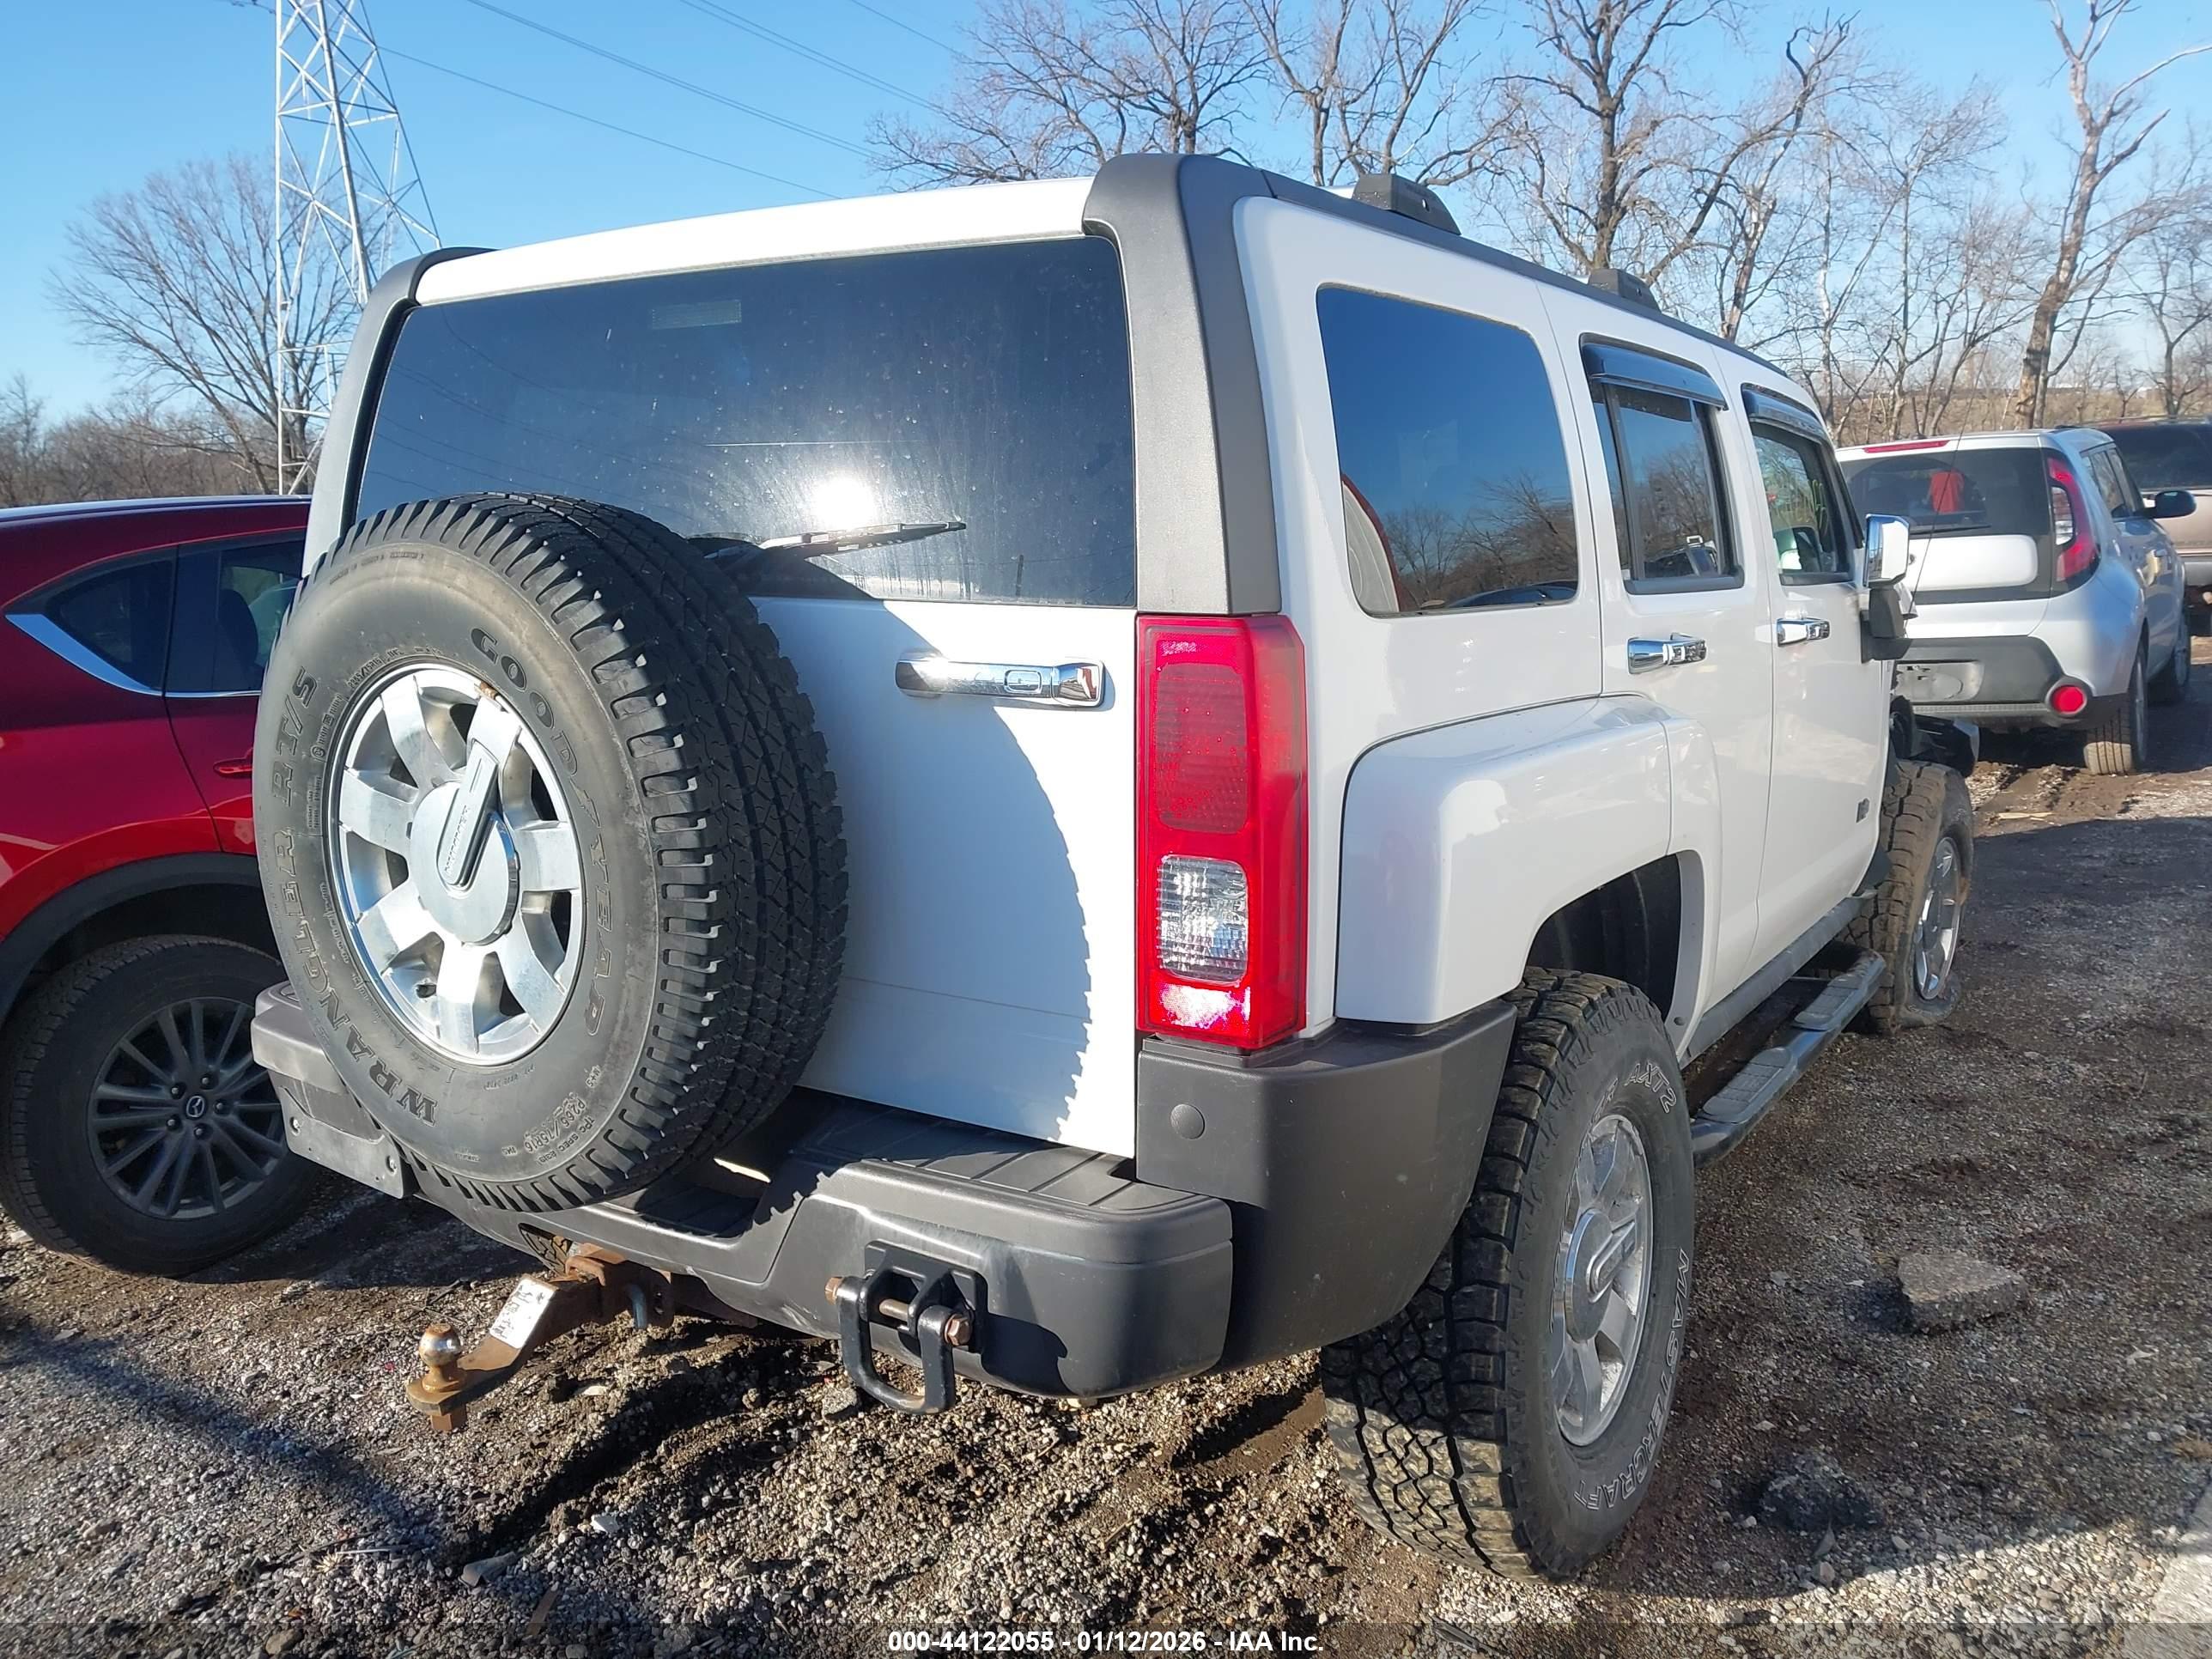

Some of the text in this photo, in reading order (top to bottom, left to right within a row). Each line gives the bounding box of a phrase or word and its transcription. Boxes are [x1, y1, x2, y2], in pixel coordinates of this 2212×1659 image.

[471, 628, 611, 1036] GOODYEAR
[274, 827, 438, 1127] WRANGLER
[524, 1097, 586, 1153] P265/75R16
[558, 1133, 580, 1152] SPEC
[579, 1115, 596, 1134] TPC
[1574, 1248, 1690, 1510] MASTERCRAFT
